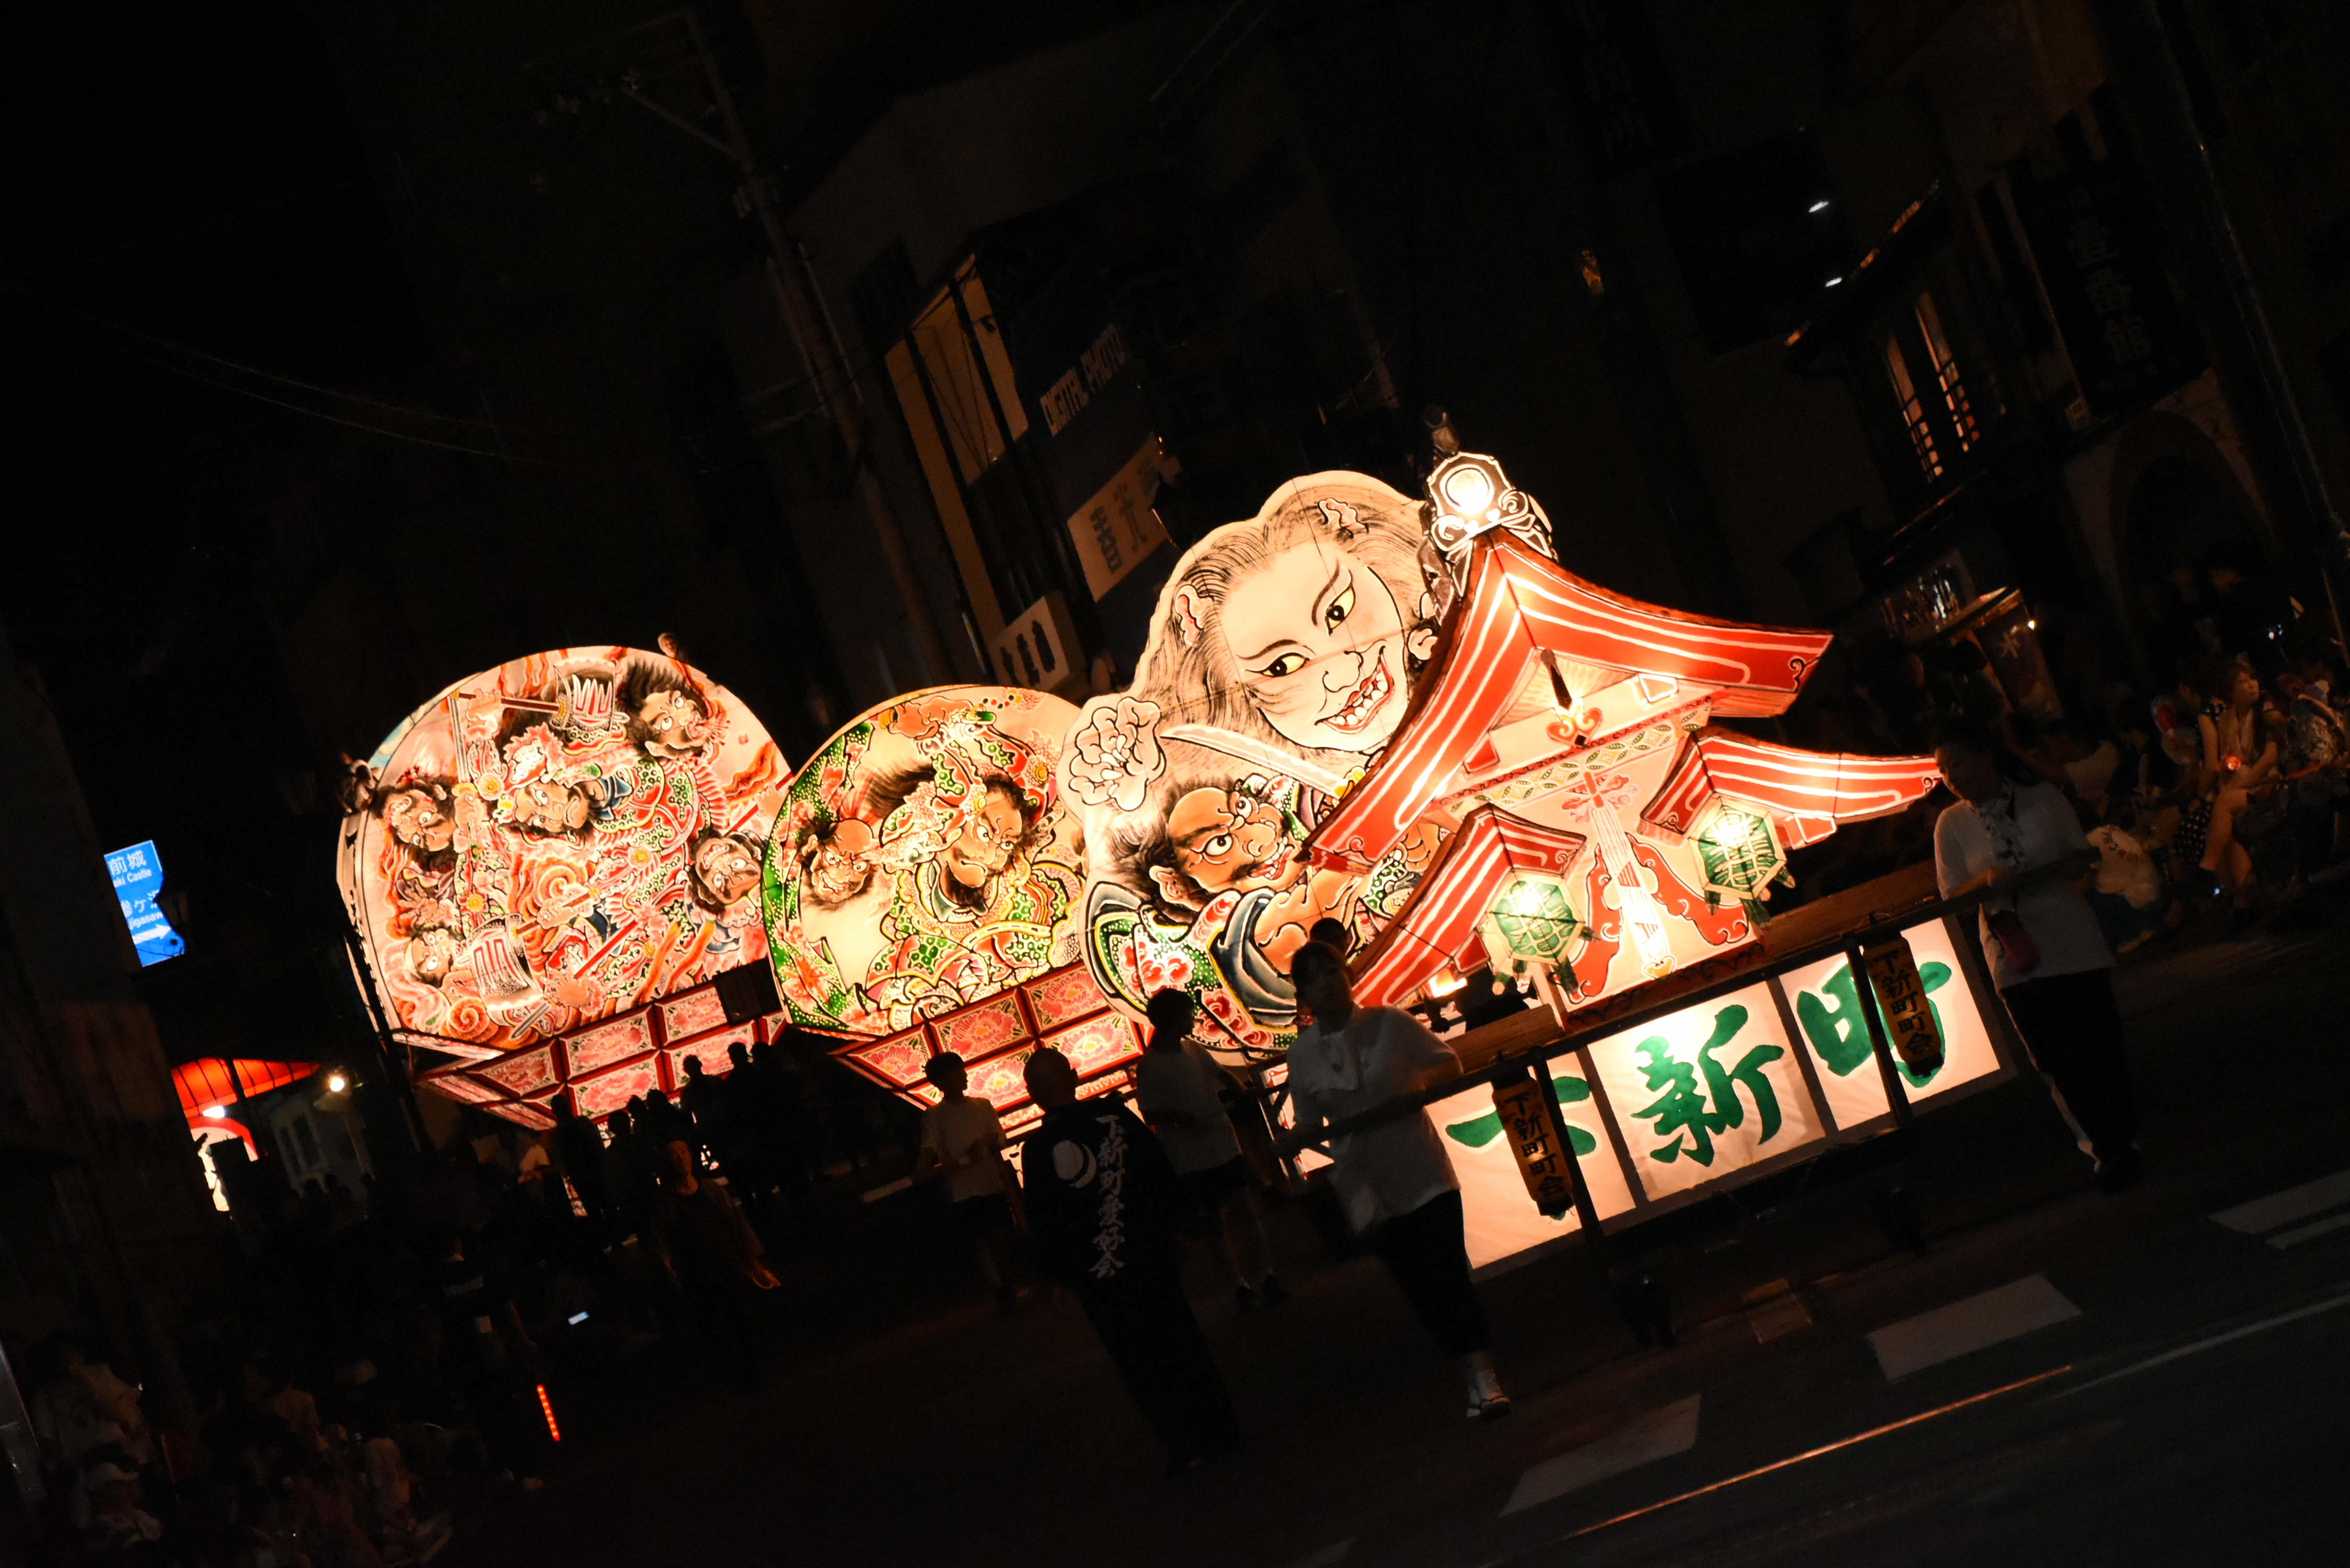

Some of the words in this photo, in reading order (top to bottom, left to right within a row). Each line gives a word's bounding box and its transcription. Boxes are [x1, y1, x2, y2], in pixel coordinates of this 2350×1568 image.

[1040, 365, 1090, 437] DIGITAL
[126, 868, 152, 883] Castle
[1873, 948, 1934, 1055] 下新町町会
[1501, 1091, 1565, 1195] 下新町町会
[1088, 1114, 1129, 1279] 下新町愛好会
